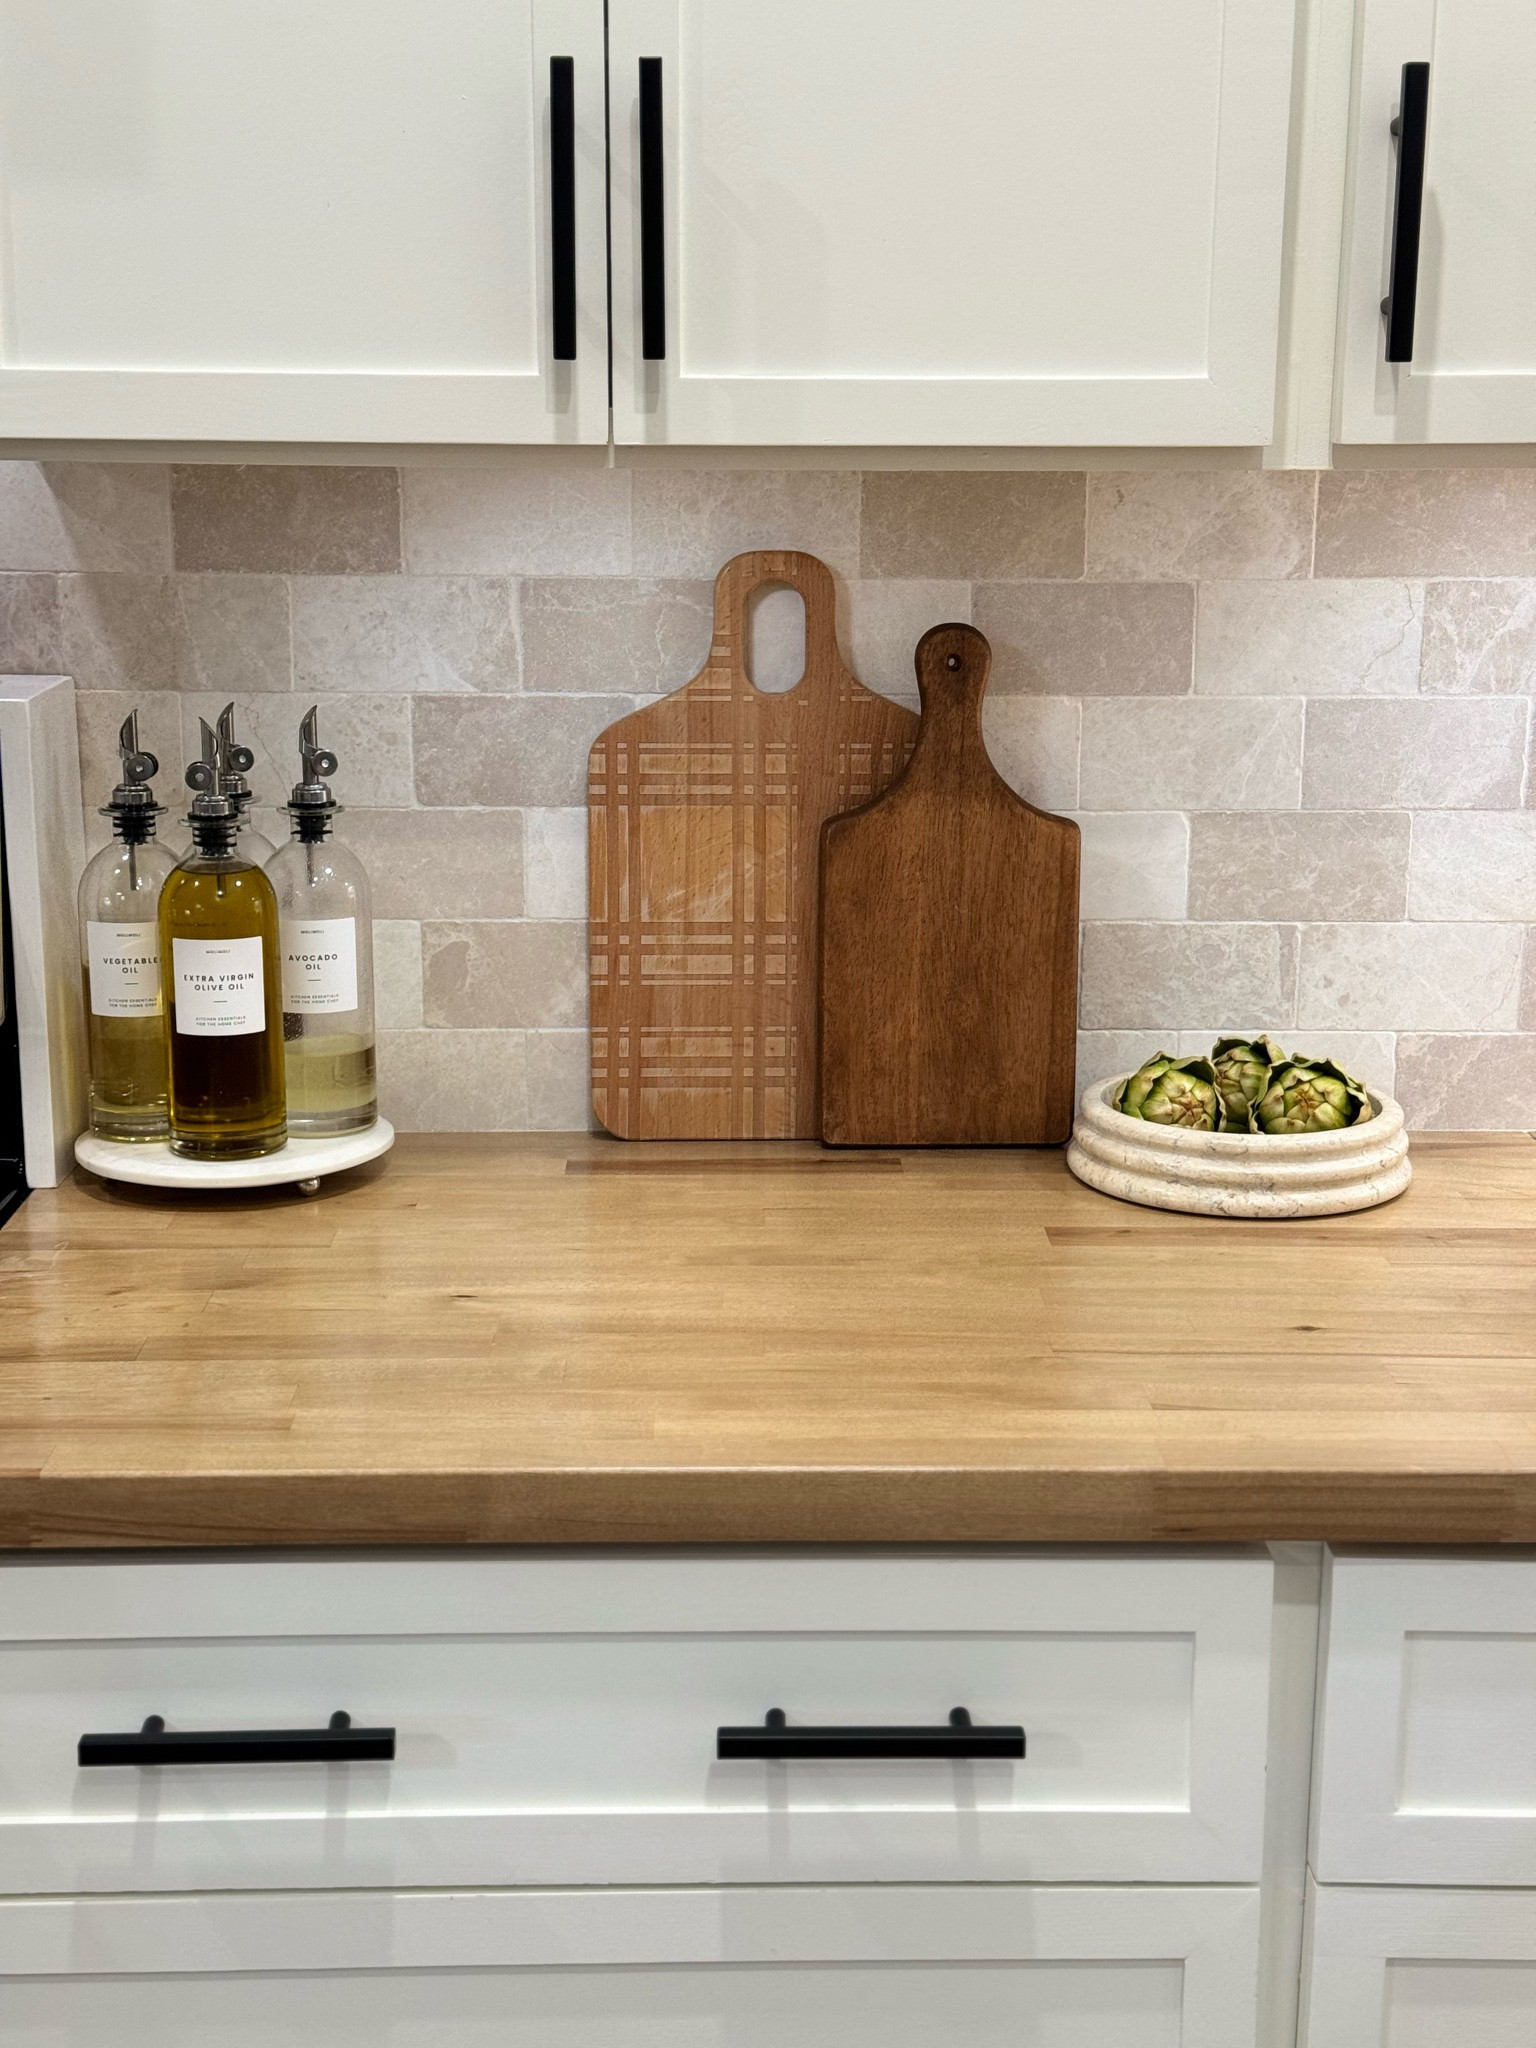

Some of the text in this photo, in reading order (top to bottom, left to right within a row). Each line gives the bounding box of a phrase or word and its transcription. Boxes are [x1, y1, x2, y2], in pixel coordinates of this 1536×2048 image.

[103, 957, 158, 965] VEGETABLE
[288, 953, 338, 962] AVOCADO
[305, 963, 321, 971] OIL
[184, 973, 254, 982] EXTRA VIRGIN
